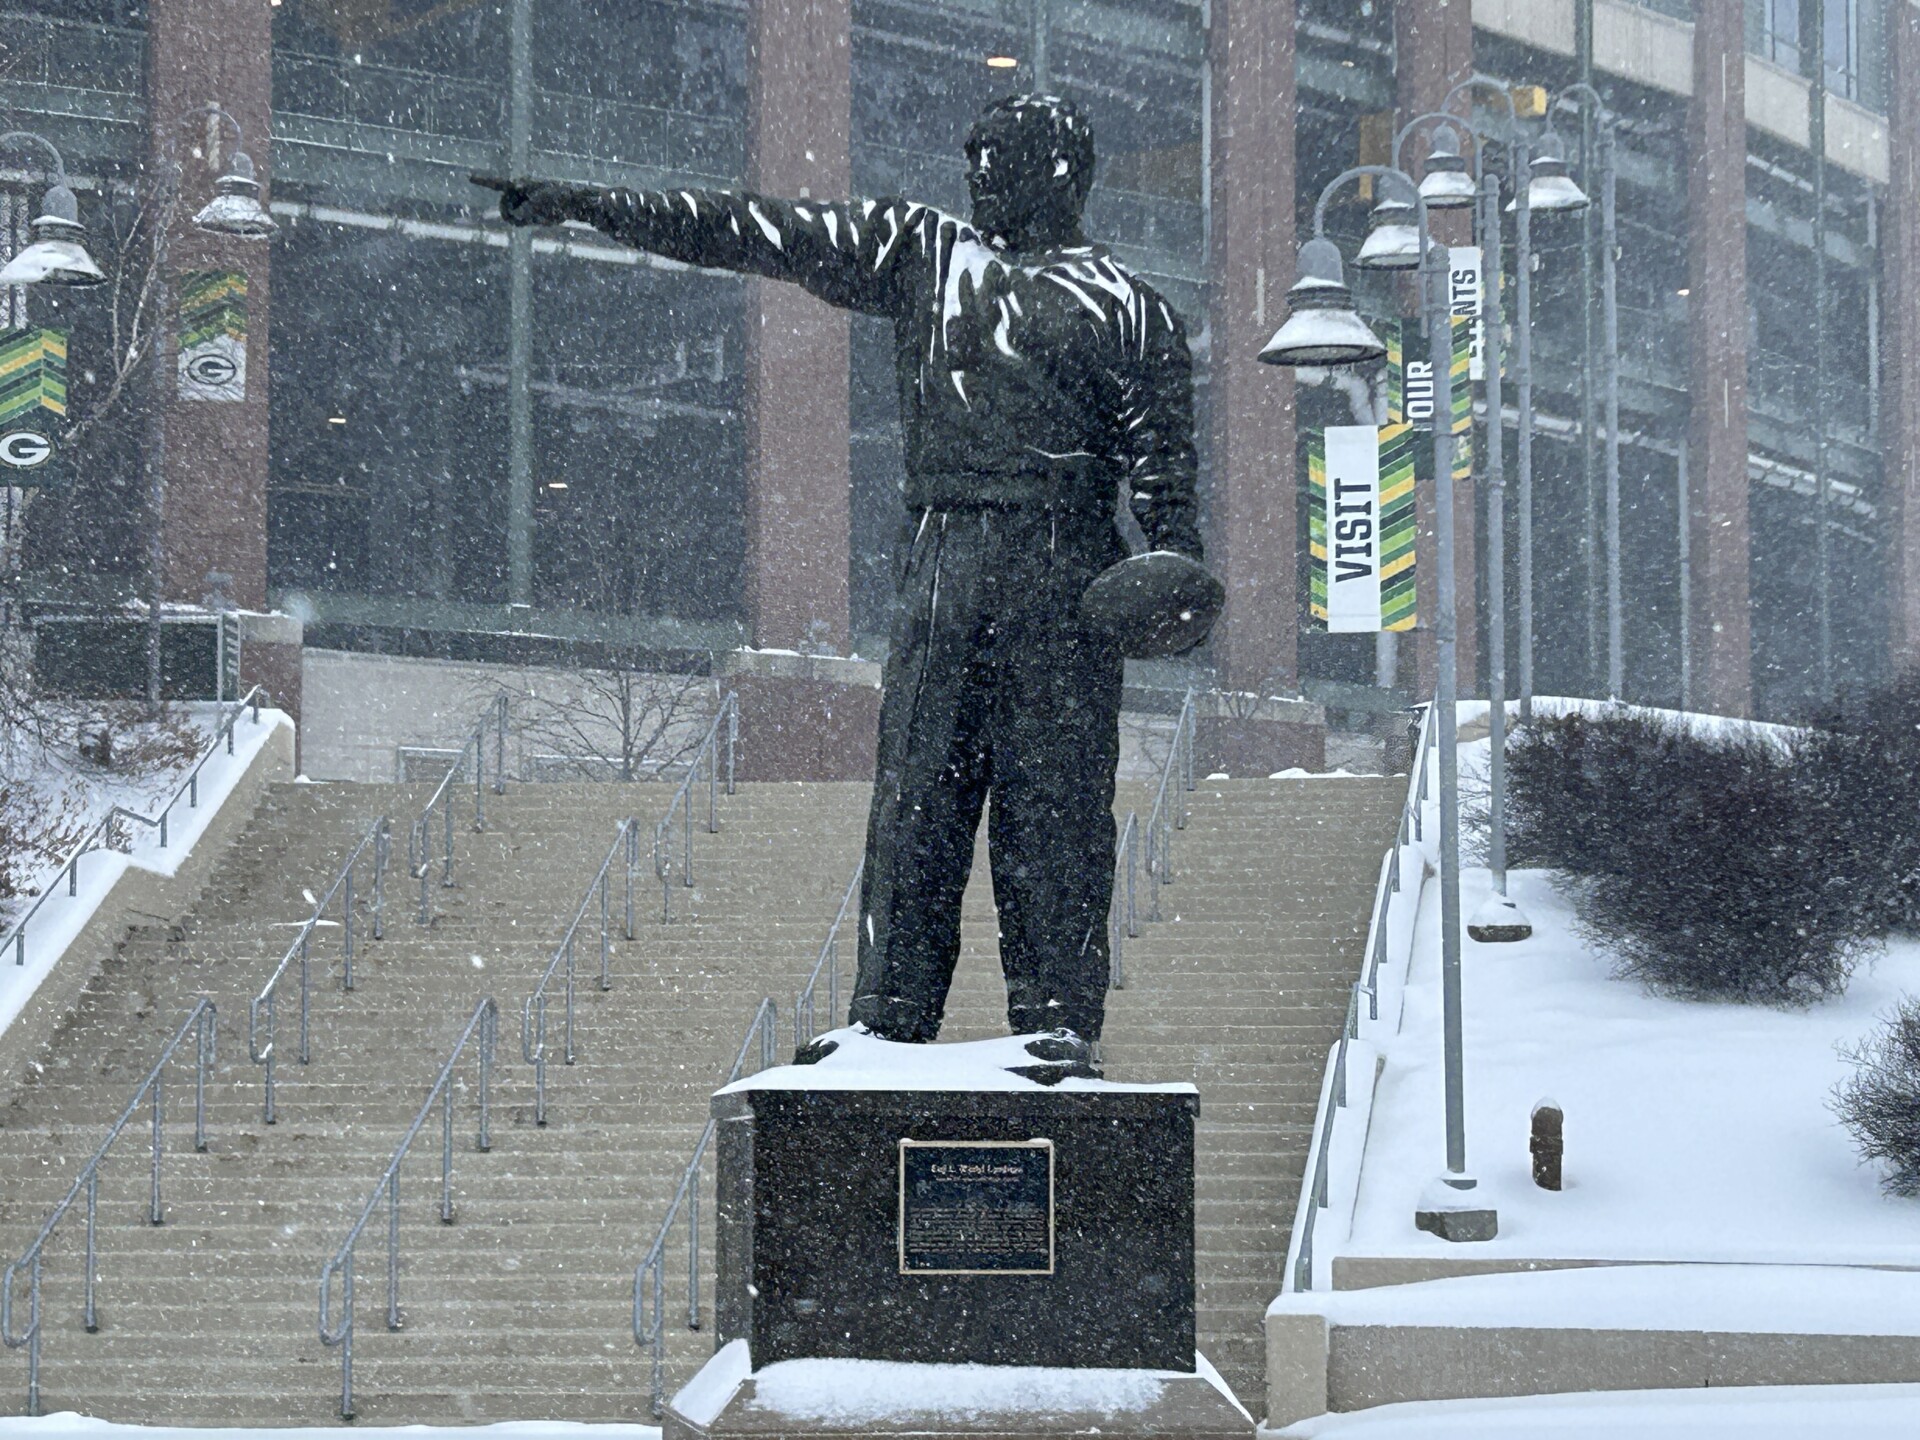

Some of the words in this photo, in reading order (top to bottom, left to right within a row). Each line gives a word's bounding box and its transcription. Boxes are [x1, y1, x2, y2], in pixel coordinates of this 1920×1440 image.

[1451, 269, 1477, 358] NTS
[189, 355, 237, 385] G
[0, 432, 51, 466] G
[1334, 477, 1372, 583] VISIT
